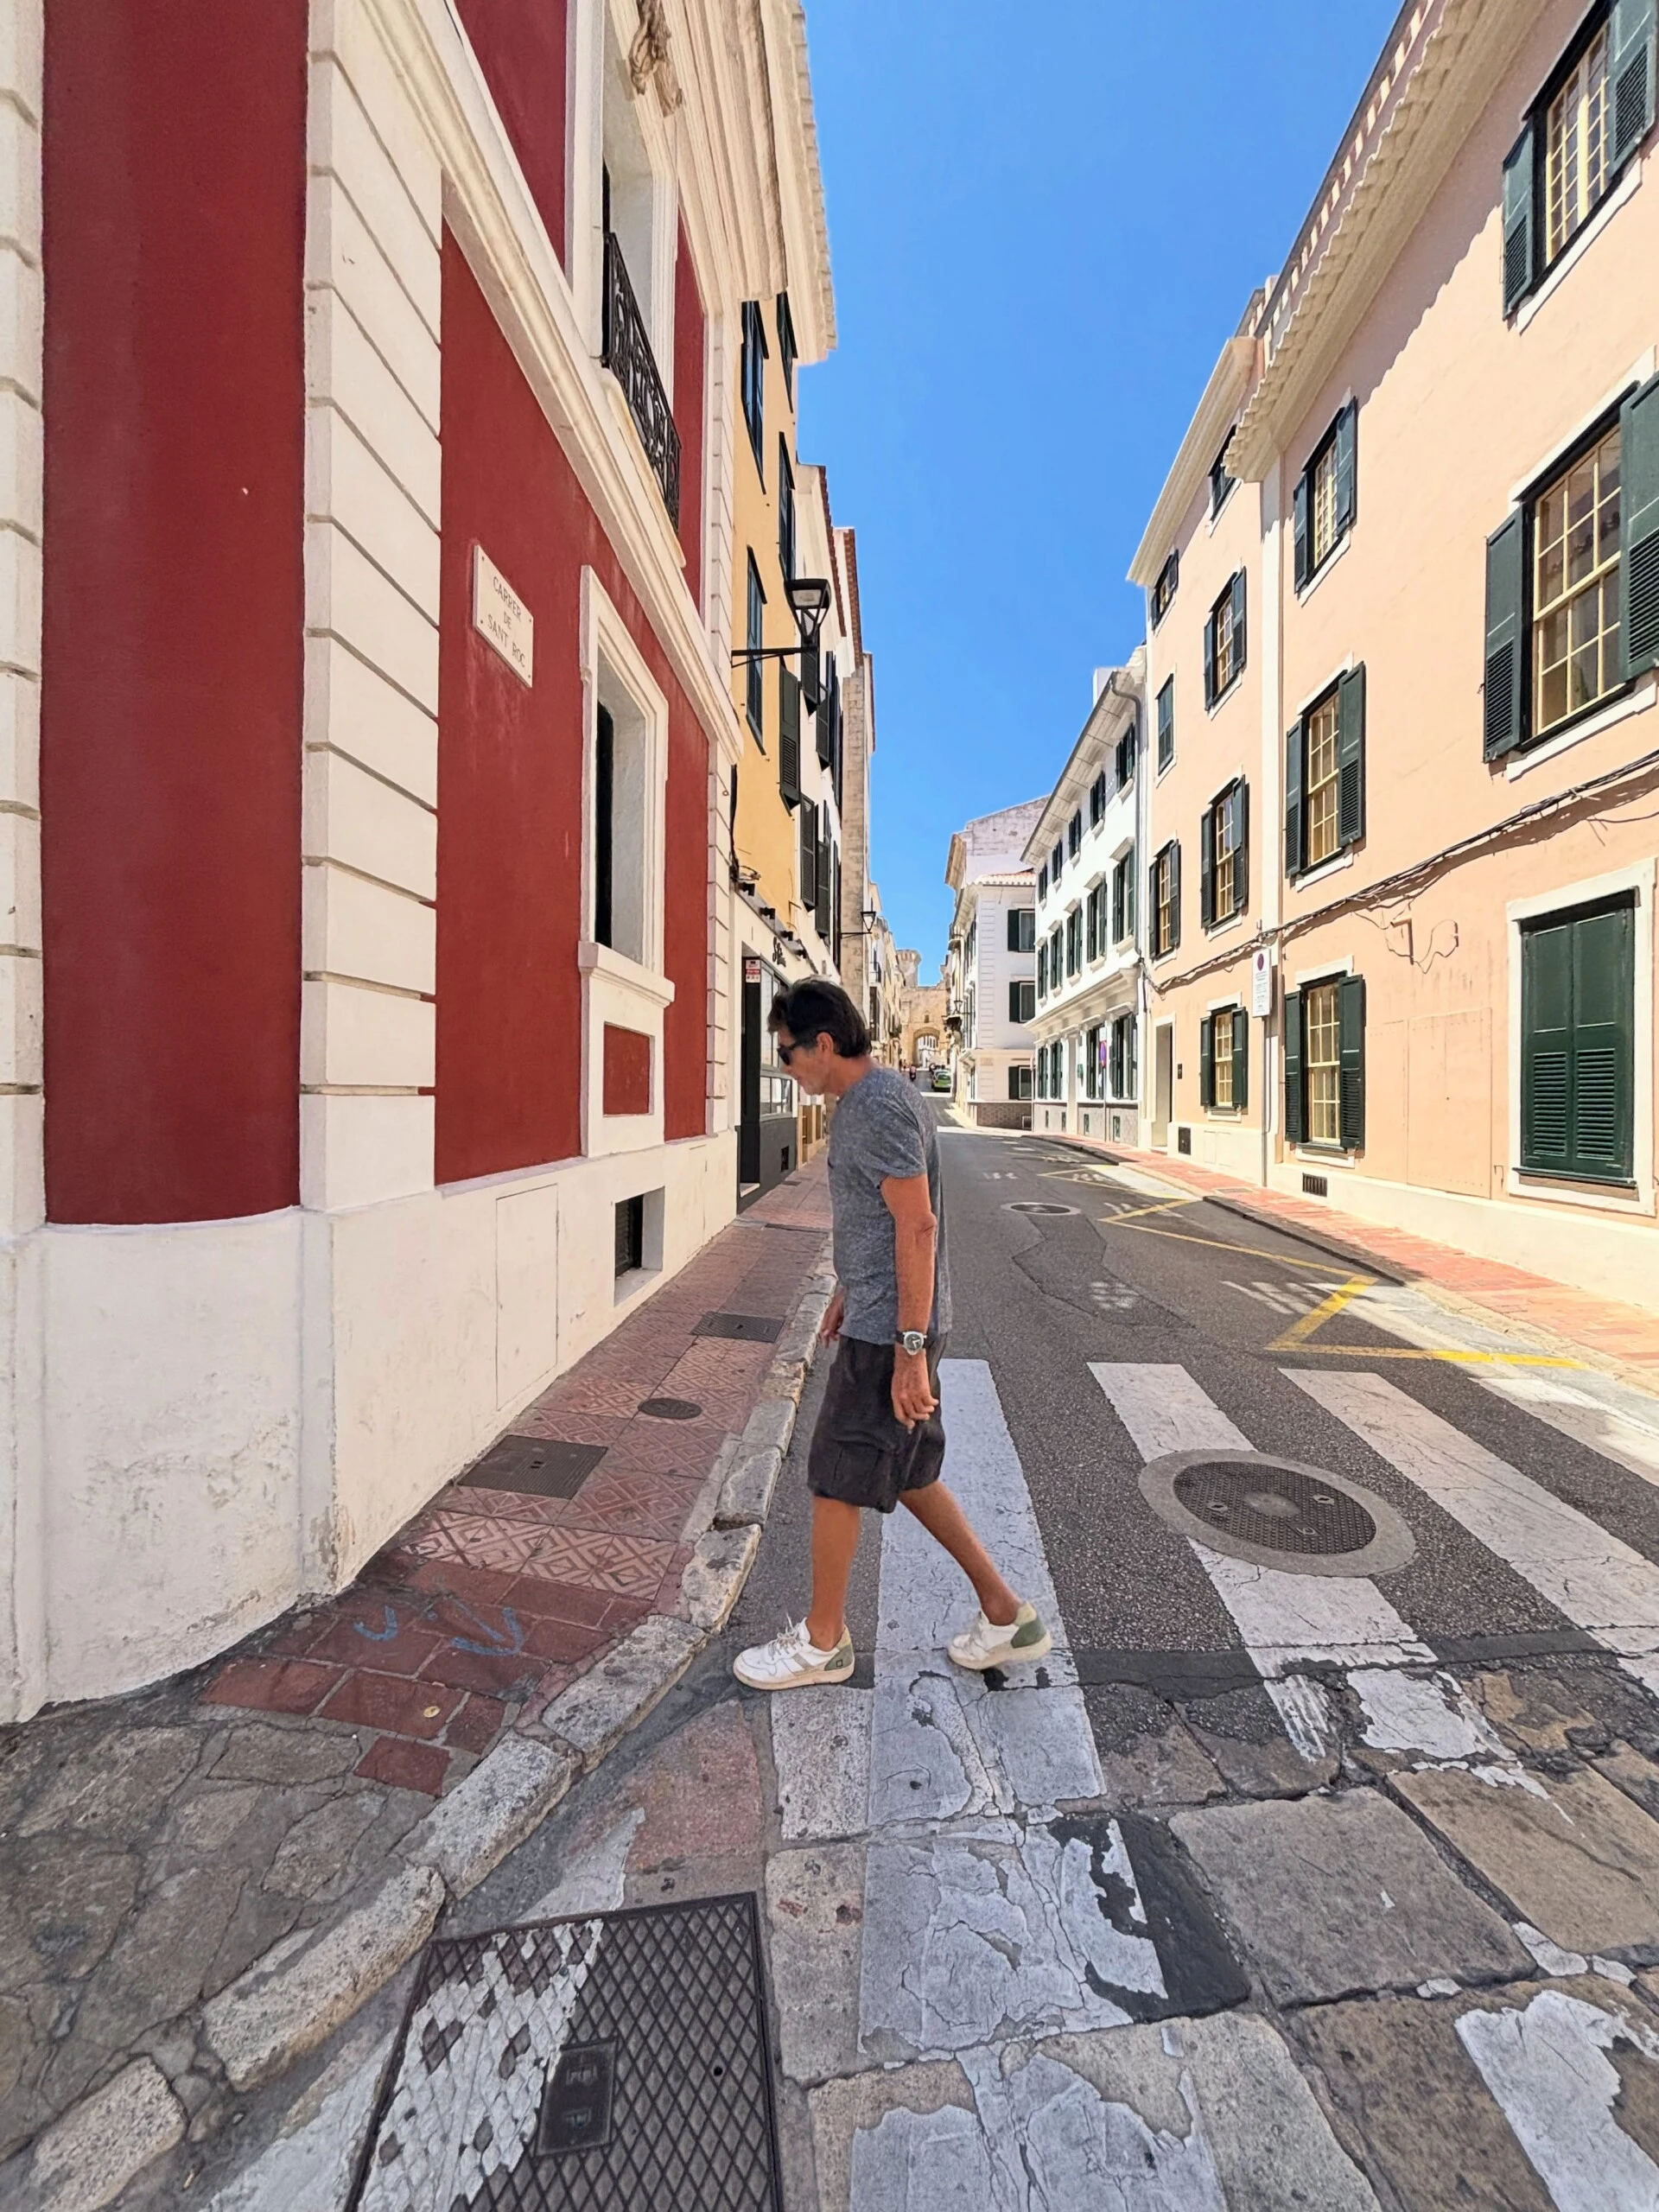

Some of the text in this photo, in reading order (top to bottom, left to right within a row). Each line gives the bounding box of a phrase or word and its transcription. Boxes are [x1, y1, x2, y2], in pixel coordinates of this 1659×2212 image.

[493, 576, 521, 622] CARRER
[504, 611, 512, 630] DE
[487, 613, 525, 668] SANT ROC
